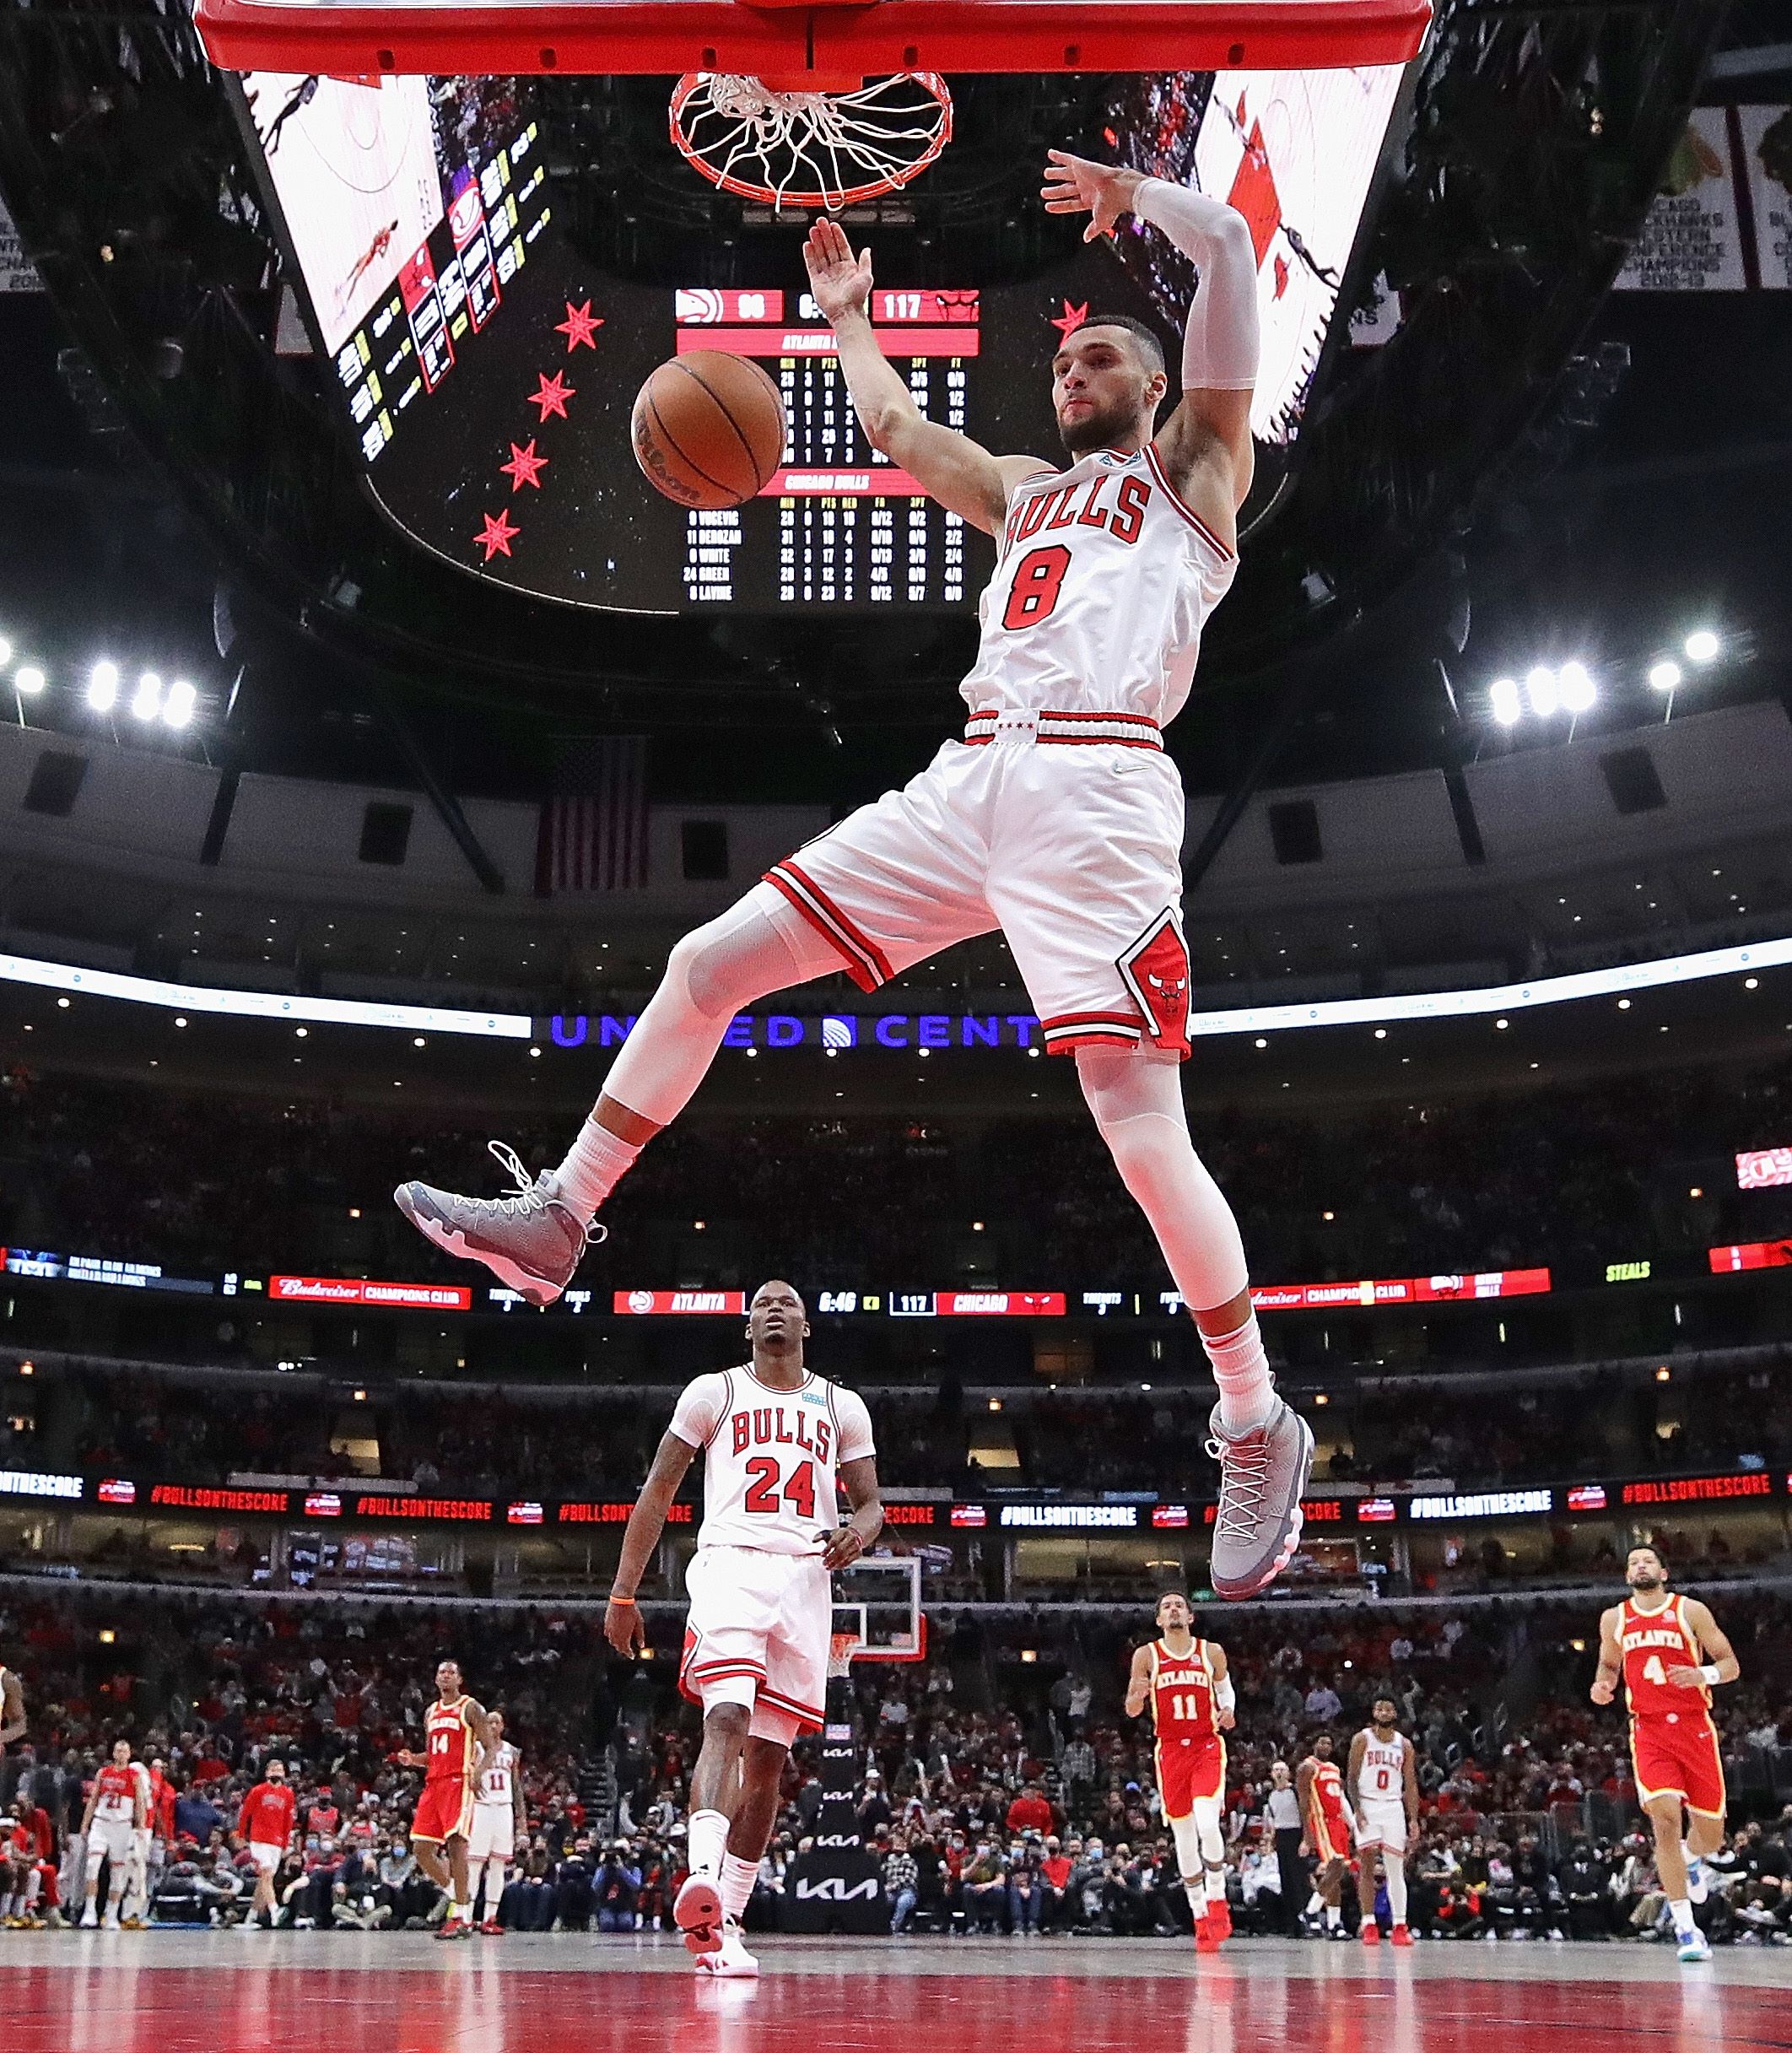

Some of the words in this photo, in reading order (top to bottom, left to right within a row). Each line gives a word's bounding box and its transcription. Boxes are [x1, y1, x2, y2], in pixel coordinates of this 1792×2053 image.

[884, 294, 922, 319] 117
[782, 334, 830, 350] ATLANTA
[823, 371, 834, 387] 11
[782, 391, 793, 406] 11
[949, 391, 964, 407] 1/2
[806, 410, 812, 425] 1
[823, 410, 834, 425] 11
[845, 410, 854, 425] 2
[949, 410, 964, 425] 1/2
[806, 429, 812, 445] 1
[805, 448, 812, 463] 1
[825, 448, 833, 463] 7
[785, 475, 834, 489] CHICAGO
[834, 475, 869, 489] BULLS
[1003, 473, 1152, 560] BULLS
[687, 529, 697, 545] 11
[699, 529, 742, 545] DEROZAN
[805, 529, 812, 545] 1
[845, 529, 853, 545] 4
[946, 529, 963, 545] 2/2
[699, 548, 731, 564] WHITE
[823, 548, 834, 564] 17
[683, 566, 697, 582] 24
[699, 566, 730, 582] GREEN
[823, 566, 834, 582] 12
[845, 566, 853, 582] 2
[845, 585, 853, 602] 2
[1001, 544, 1072, 630] 8
[551, 1015, 804, 1047] UNED
[875, 1015, 1039, 1047] CENT
[1606, 1262, 1650, 1282] STEALS
[279, 1278, 359, 1298] Budweiser
[365, 1286, 429, 1302] CHAMPIONS
[431, 1291, 460, 1305] CLUB
[671, 1293, 726, 1311] ATLANTA
[818, 1291, 856, 1312] 6:46
[901, 1295, 927, 1311] 117
[954, 1294, 1008, 1313] CHICAGO
[1251, 1291, 1302, 1306] dweiser
[1376, 1284, 1406, 1299] CLUB
[732, 1407, 831, 1465] BULLS
[151, 1484, 289, 1511] #BULLSONTHESCORE
[745, 1456, 815, 1518] 24
[1622, 1473, 1772, 1504] #BULLSONTHESCORE
[356, 1497, 493, 1520] #BULLSONTHESCORE
[1411, 1489, 1552, 1518] #BULLSONTHESCORE
[1001, 1506, 1137, 1526] #BULLSONTHESCORE
[1622, 1629, 1684, 1651] ATLANTA
[1158, 1670, 1208, 1688] ATLANTA
[1643, 1655, 1667, 1685] 4
[1173, 1694, 1198, 1720] 11
[432, 1733, 449, 1755] 14
[490, 1774, 505, 1791] 11
[1378, 1769, 1389, 1790] 0
